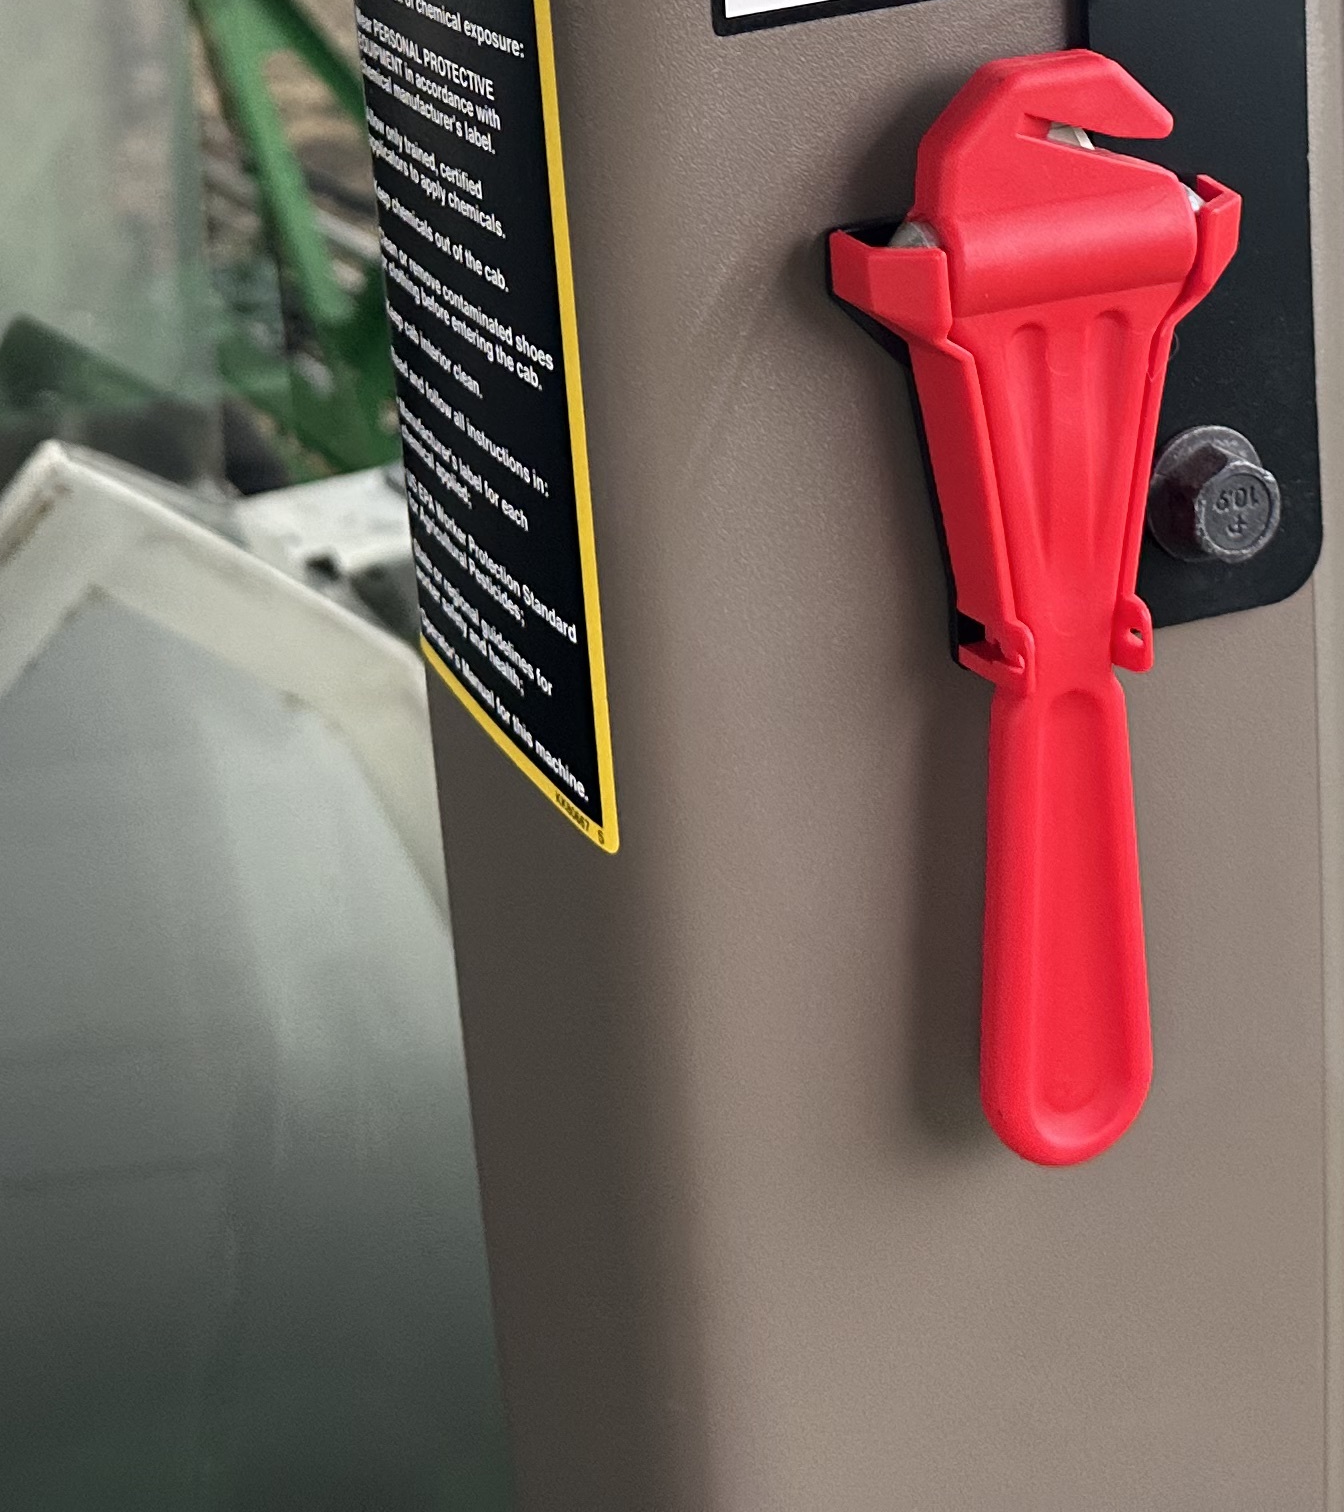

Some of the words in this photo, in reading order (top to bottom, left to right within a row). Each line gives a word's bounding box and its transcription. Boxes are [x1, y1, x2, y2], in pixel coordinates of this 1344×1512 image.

[372, 18, 423, 65] PERSONAL
[422, 47, 495, 101] PROTECTIVE
[463, 19, 525, 59] exposure:
[357, 30, 403, 77] EQUIPMENT
[403, 61, 415, 85] in
[415, 72, 474, 118] accordance
[475, 104, 501, 131] with
[392, 83, 463, 138] manufacturer's
[463, 120, 496, 155] label.
[385, 125, 403, 153] only
[403, 135, 439, 177] trained,
[439, 162, 483, 200] certified
[409, 162, 420, 184] to
[420, 173, 446, 207] apply
[447, 190, 506, 239] chemicals.
[391, 197, 434, 242] chemicals
[434, 231, 452, 256] out
[451, 244, 464, 264] of
[464, 248, 483, 276] the
[484, 265, 509, 293] cab.
[388, 261, 421, 305] clothing
[420, 286, 451, 326] before
[451, 315, 495, 362] entering
[494, 343, 515, 372] the
[516, 361, 543, 391] cab.
[398, 249, 408, 267] or
[408, 257, 442, 295] remove
[442, 285, 514, 347] contaminated
[515, 334, 554, 371] shoes
[404, 321, 420, 345] cab
[419, 331, 452, 373] interior
[452, 363, 483, 399] clean.
[409, 369, 425, 395] and
[425, 381, 452, 419] follow
[453, 410, 466, 432] all
[465, 417, 531, 484] instructions
[532, 468, 550, 498] in:
[458, 457, 483, 494] label
[483, 480, 500, 508] for
[501, 498, 529, 532] each
[434, 500, 467, 546] Worker
[467, 534, 521, 598] Protection
[522, 584, 578, 644] Standard
[468, 557, 526, 628] Pesticides;
[469, 627, 488, 657] and
[487, 643, 525, 696] health;
[480, 618, 535, 680] guidelines
[535, 667, 553, 696] for
[495, 696, 511, 725] for
[511, 714, 534, 748] this
[535, 740, 589, 802] machine.
